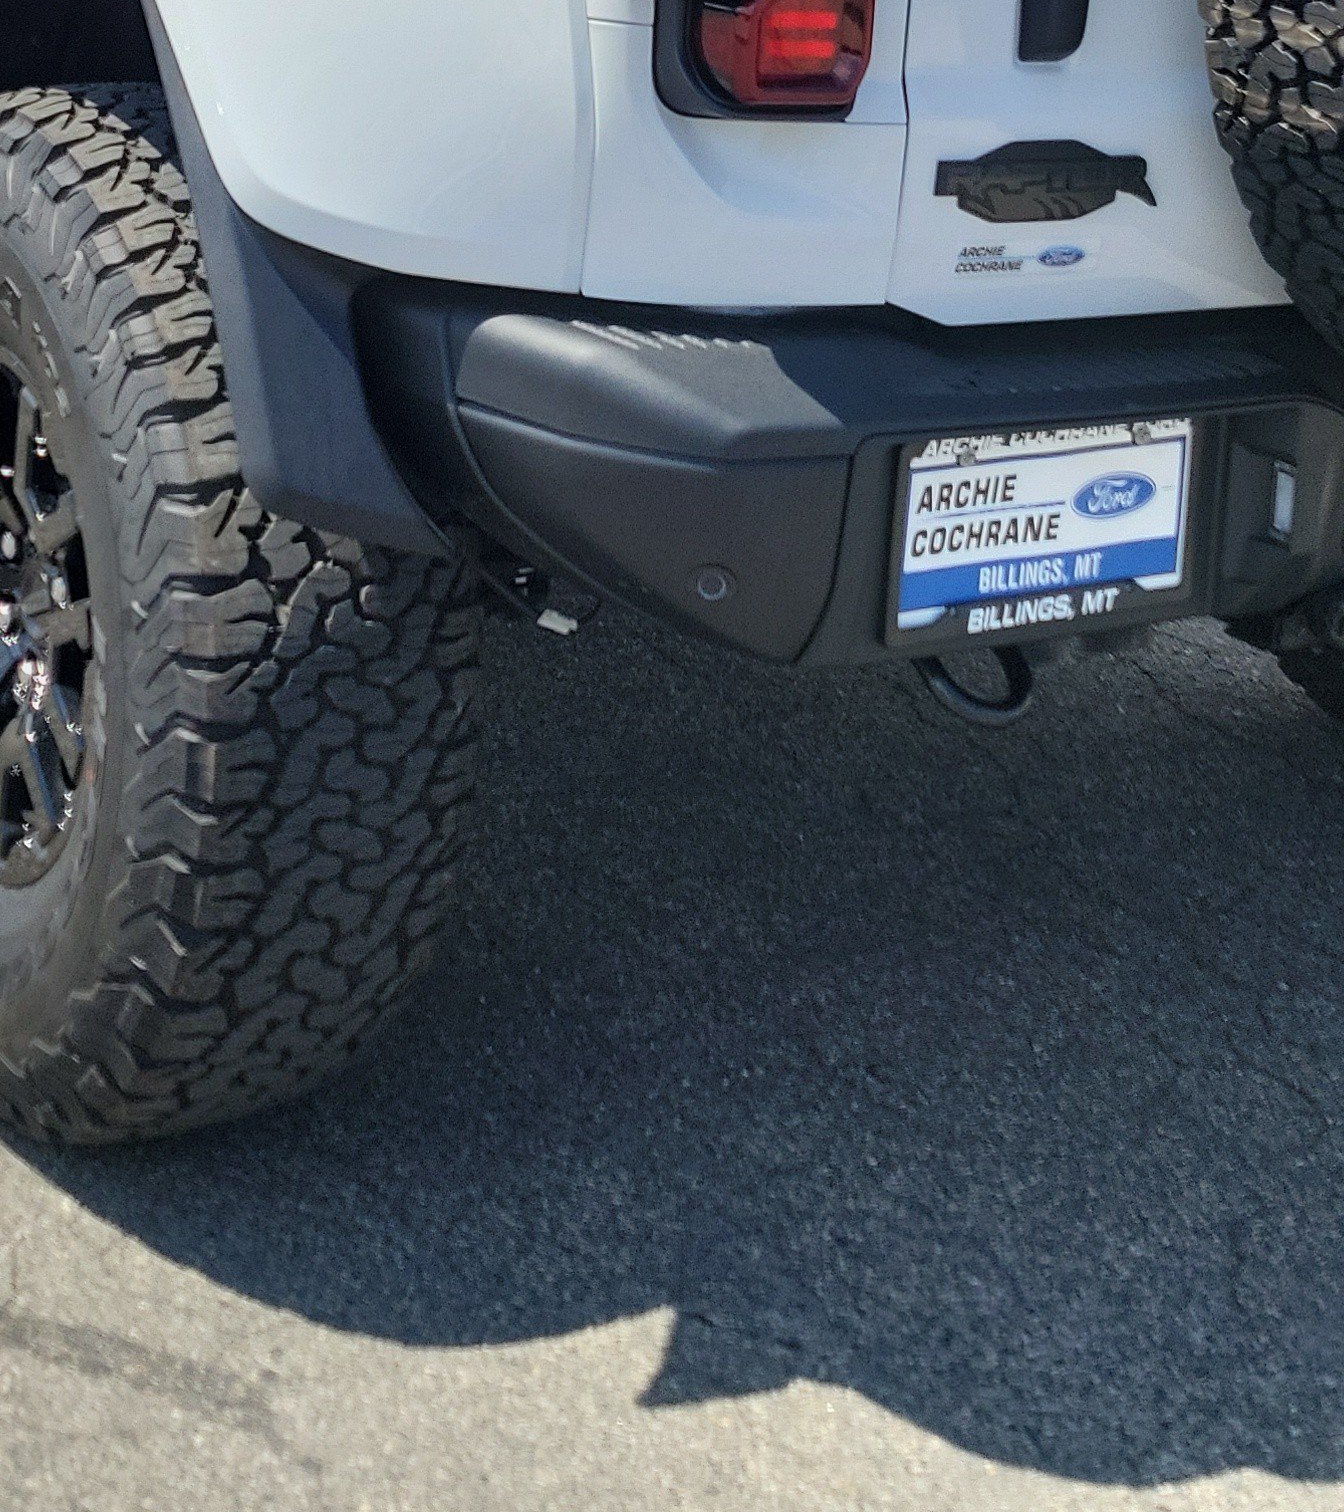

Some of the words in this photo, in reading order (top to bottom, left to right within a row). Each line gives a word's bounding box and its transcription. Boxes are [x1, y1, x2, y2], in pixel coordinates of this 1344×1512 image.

[954, 258, 1024, 274] COCHRANE
[959, 244, 1006, 258] ARCHIE
[916, 474, 1017, 514] ARCHIE
[910, 512, 1061, 559] COCHRANE
[977, 557, 1068, 595] BILLINGS,
[1074, 551, 1102, 580] MT
[966, 594, 1074, 635] BILLINGS,
[1081, 587, 1122, 616] MT
